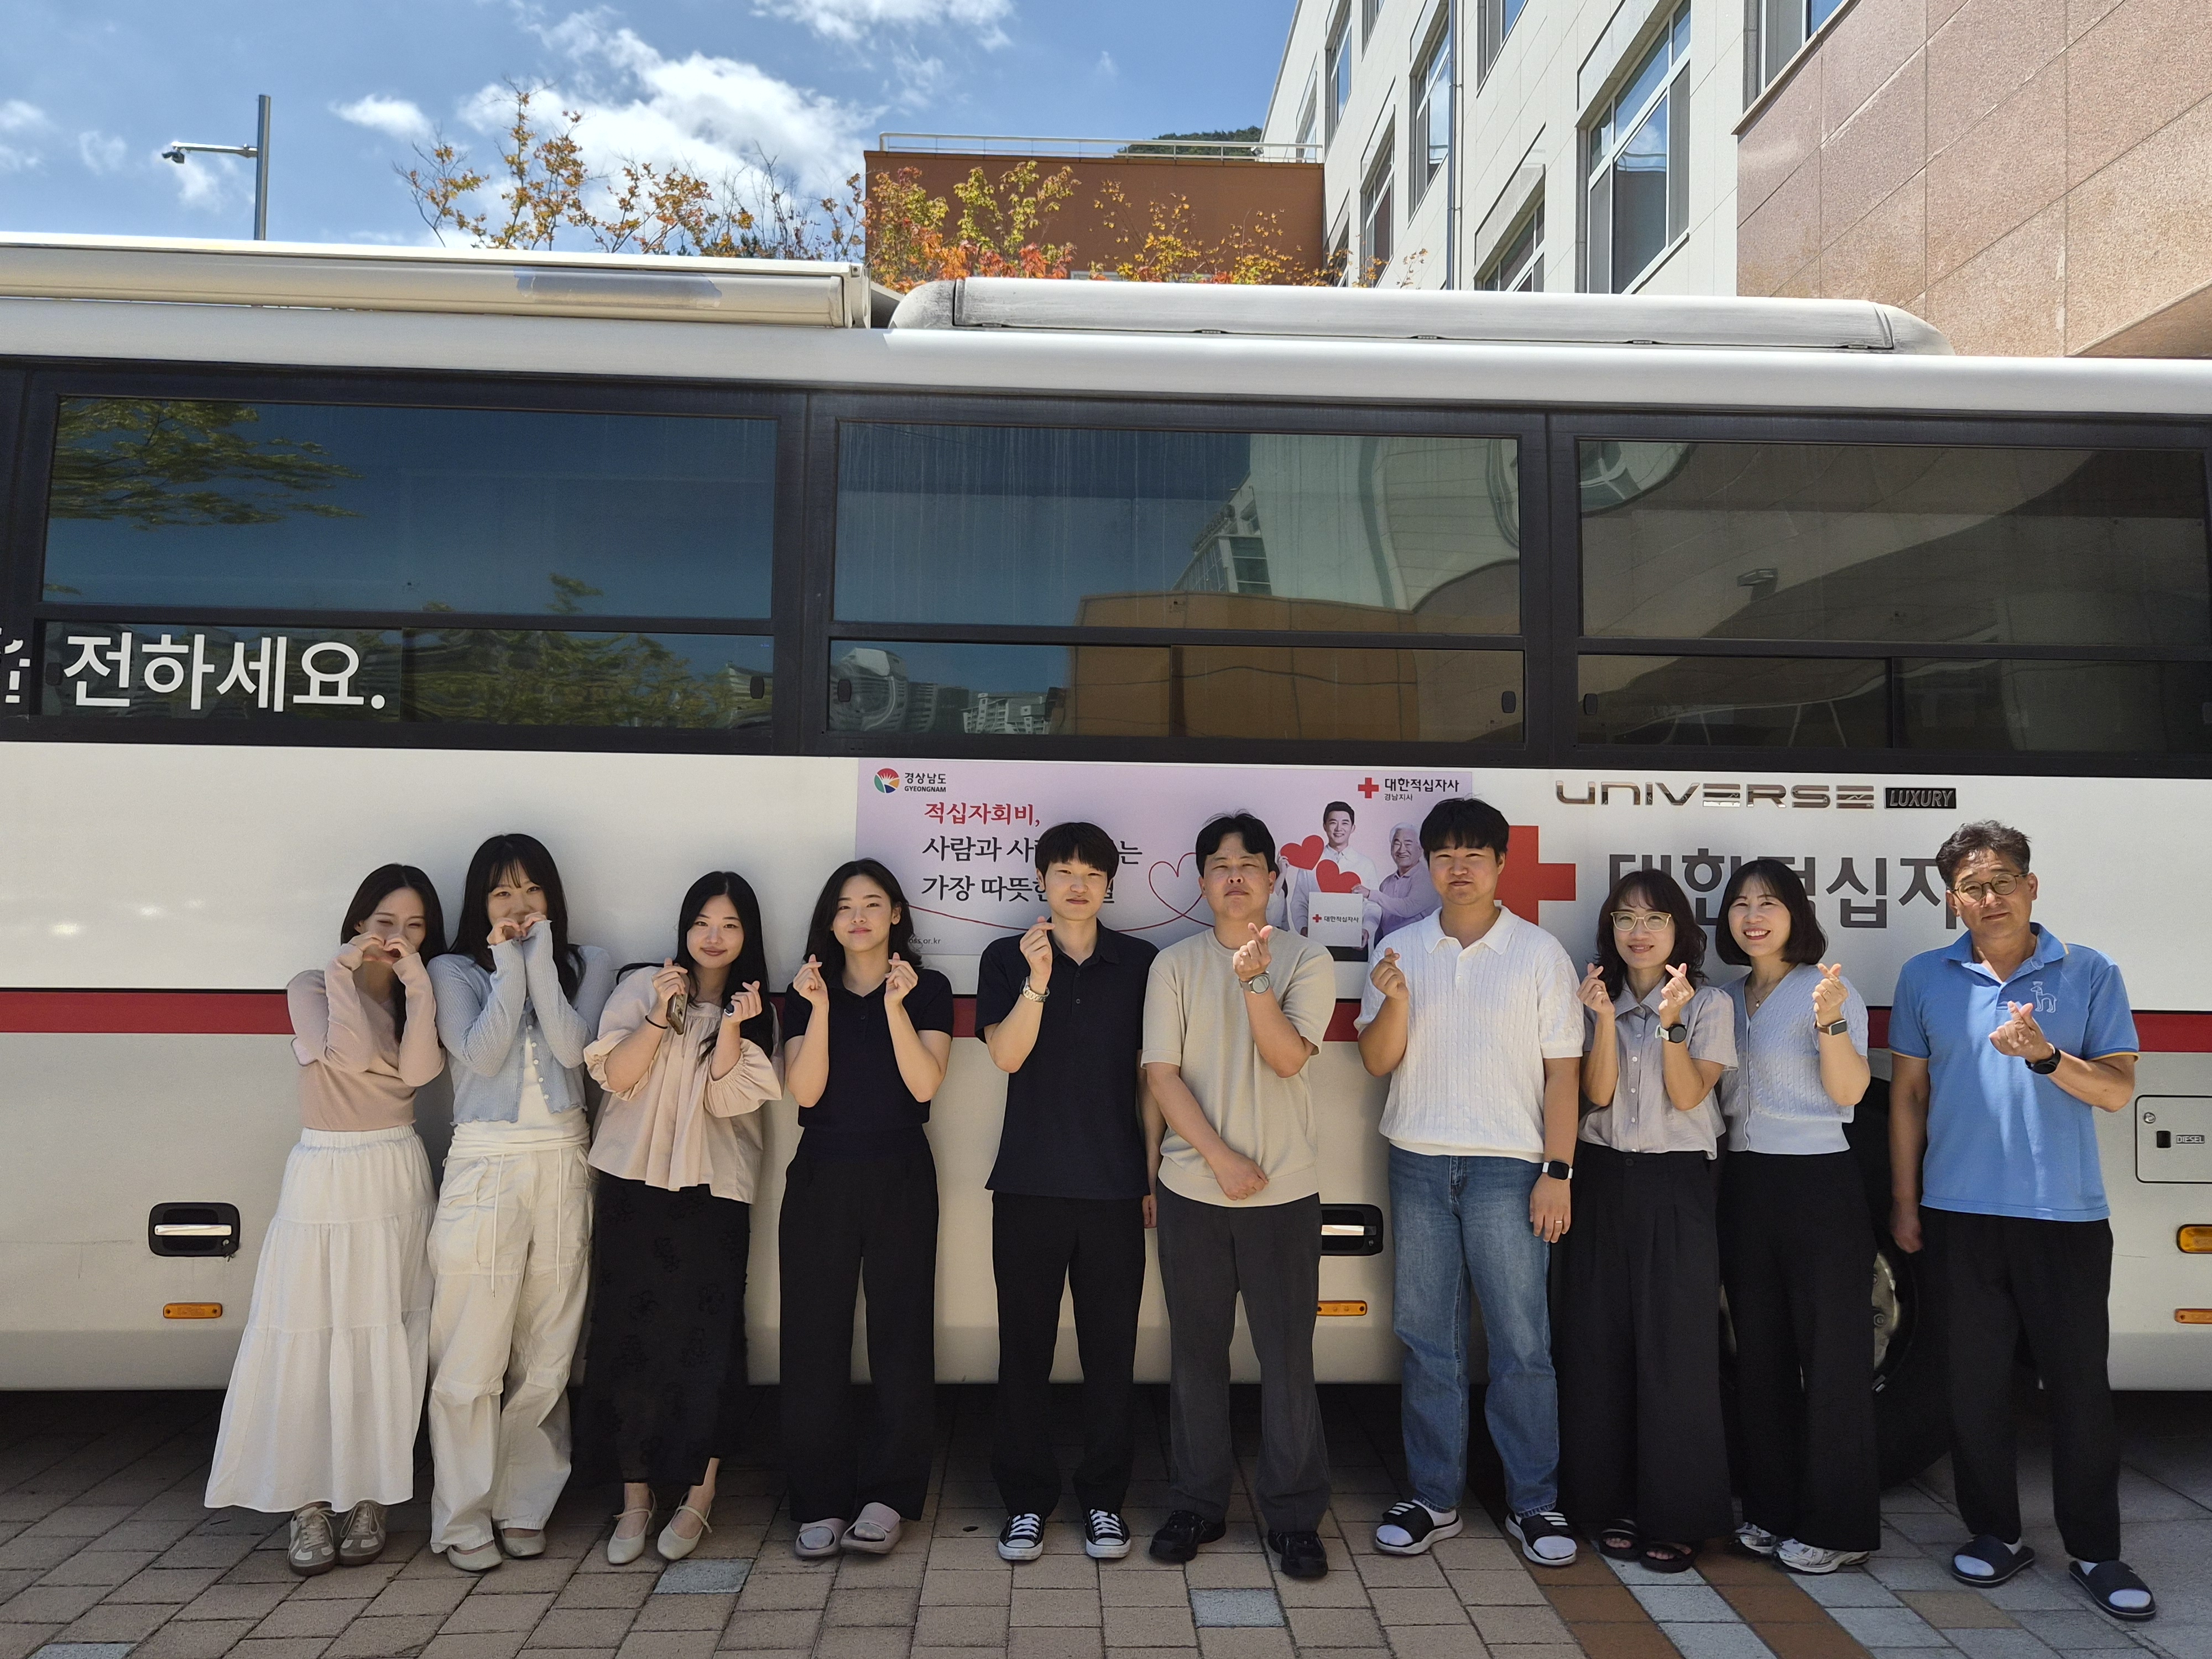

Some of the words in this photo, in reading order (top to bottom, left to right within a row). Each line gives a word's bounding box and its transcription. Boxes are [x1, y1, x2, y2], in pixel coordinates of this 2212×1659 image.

[63, 632, 385, 712] 전하세요.
[905, 773, 946, 784] 경상남도
[1385, 778, 1459, 792] 대한적십자사
[1556, 780, 1874, 809] UNIVERSE
[1888, 789, 1954, 807] LUXURY
[924, 802, 1040, 827] 적십자회비,
[922, 836, 1002, 862] 사람과
[1006, 837, 1040, 863] 사
[921, 875, 975, 901] 가장
